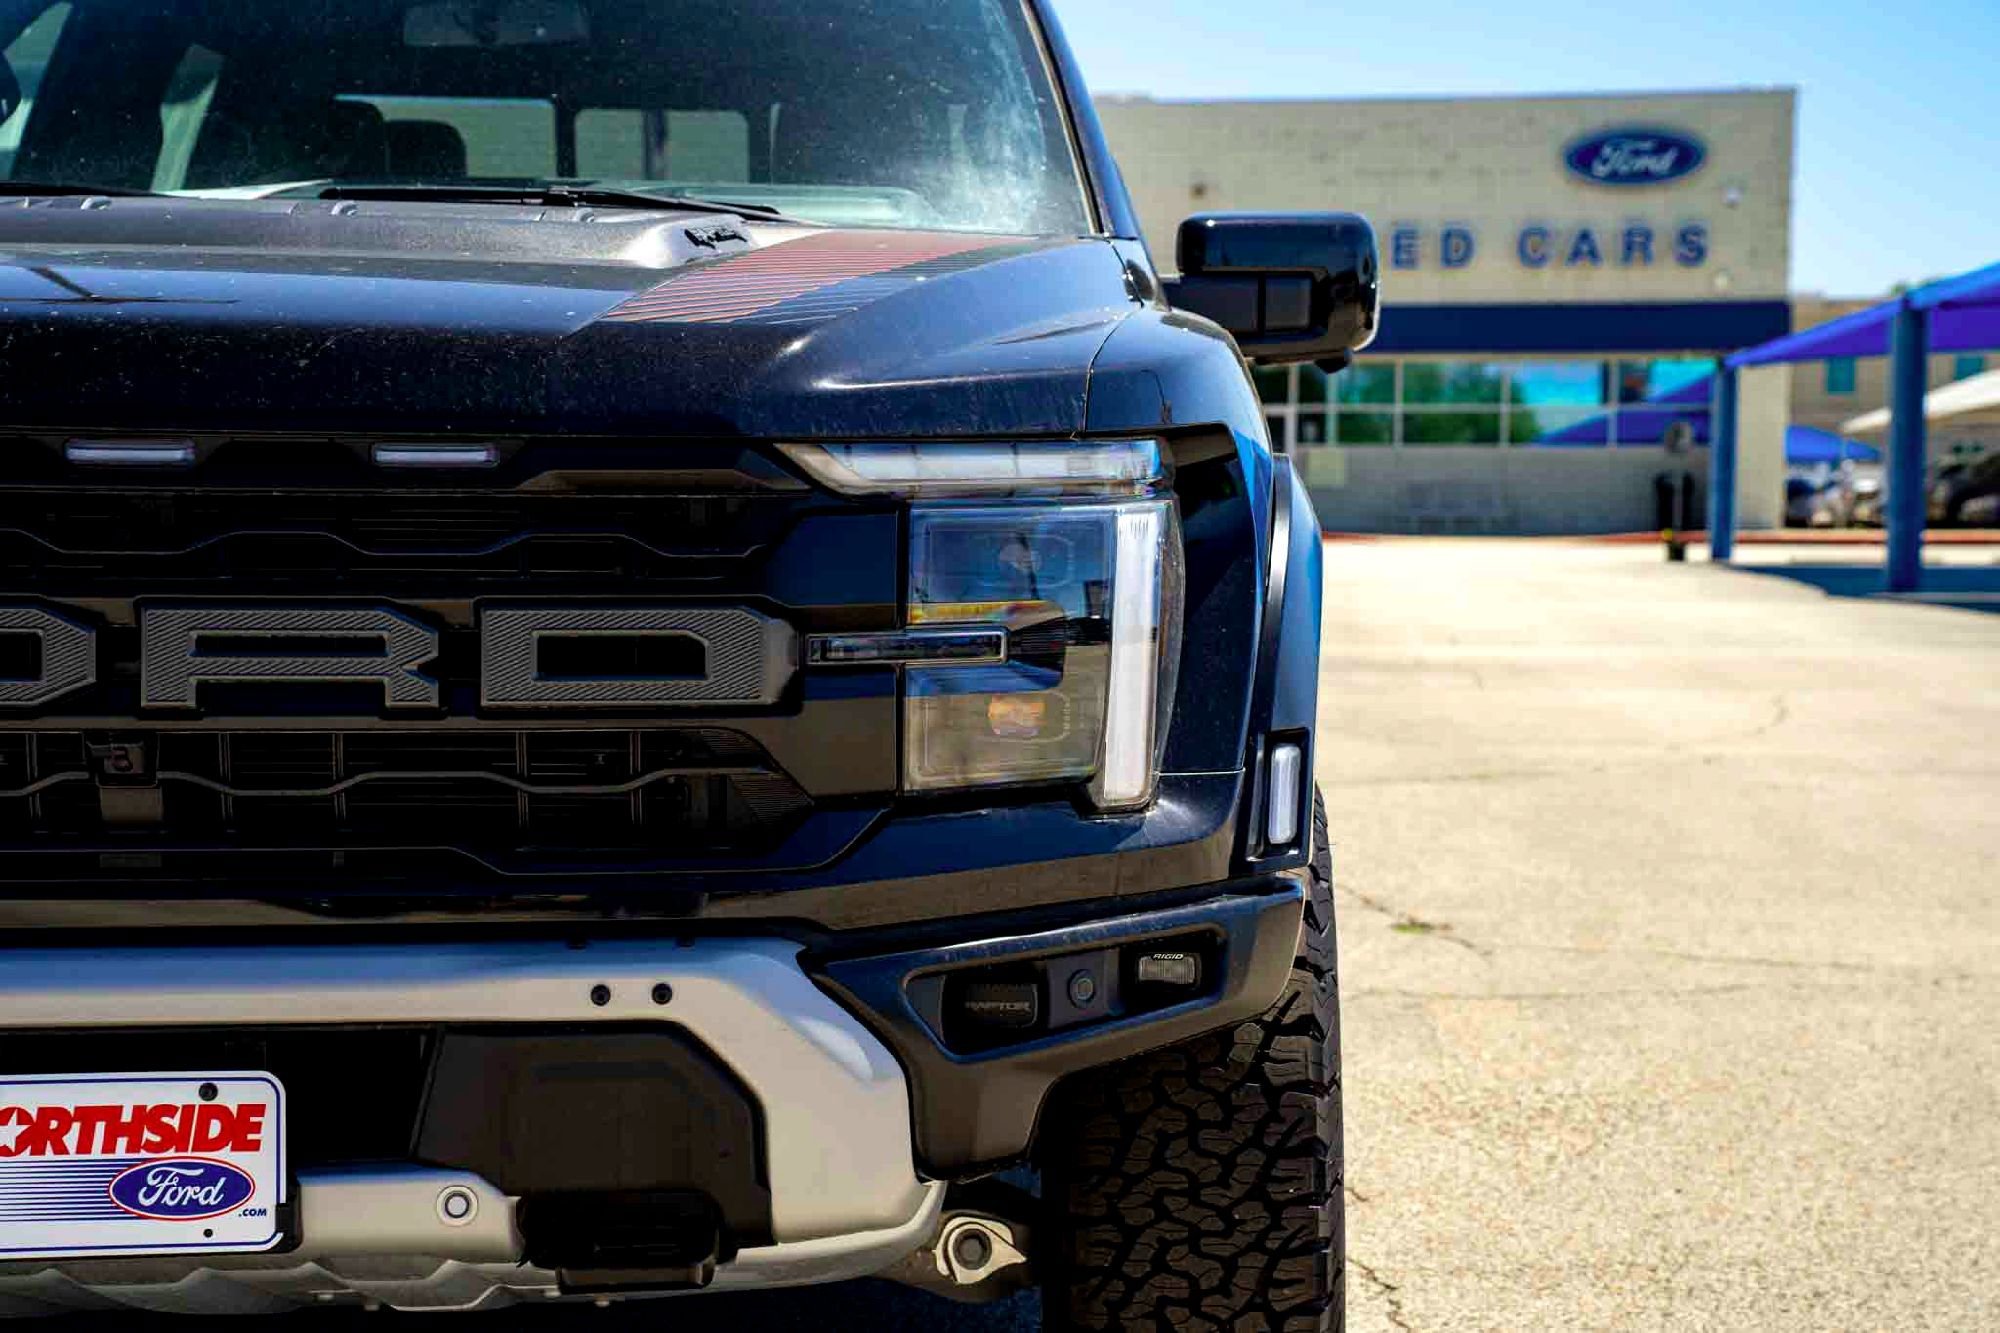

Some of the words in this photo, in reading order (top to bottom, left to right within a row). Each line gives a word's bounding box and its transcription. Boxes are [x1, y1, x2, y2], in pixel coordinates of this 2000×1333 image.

[1391, 226, 1475, 268] ED
[1516, 225, 1709, 268] CARS
[1152, 952, 1184, 960] RIGID
[138, 1166, 226, 1207] Ford
[238, 1207, 267, 1217] .COM
